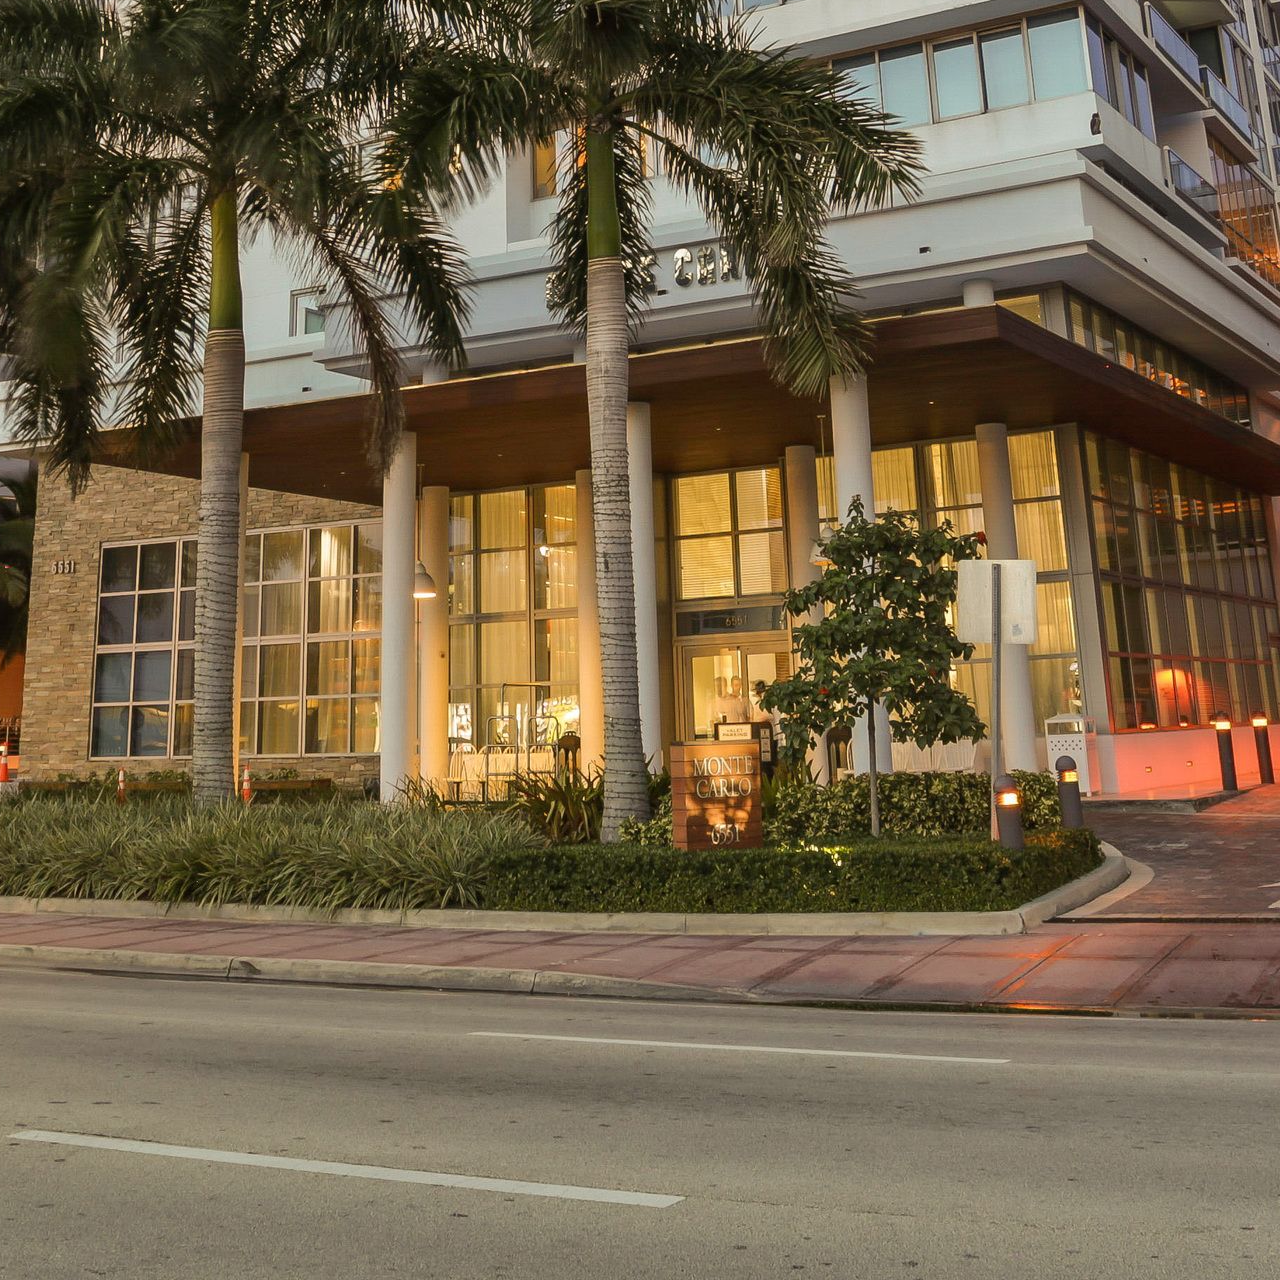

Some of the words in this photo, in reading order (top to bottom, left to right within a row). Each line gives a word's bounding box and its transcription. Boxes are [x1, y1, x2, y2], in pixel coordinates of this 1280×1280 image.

[693, 755, 753, 777] MONTE
[696, 777, 752, 799] CARLO
[711, 823, 740, 845] 6551
